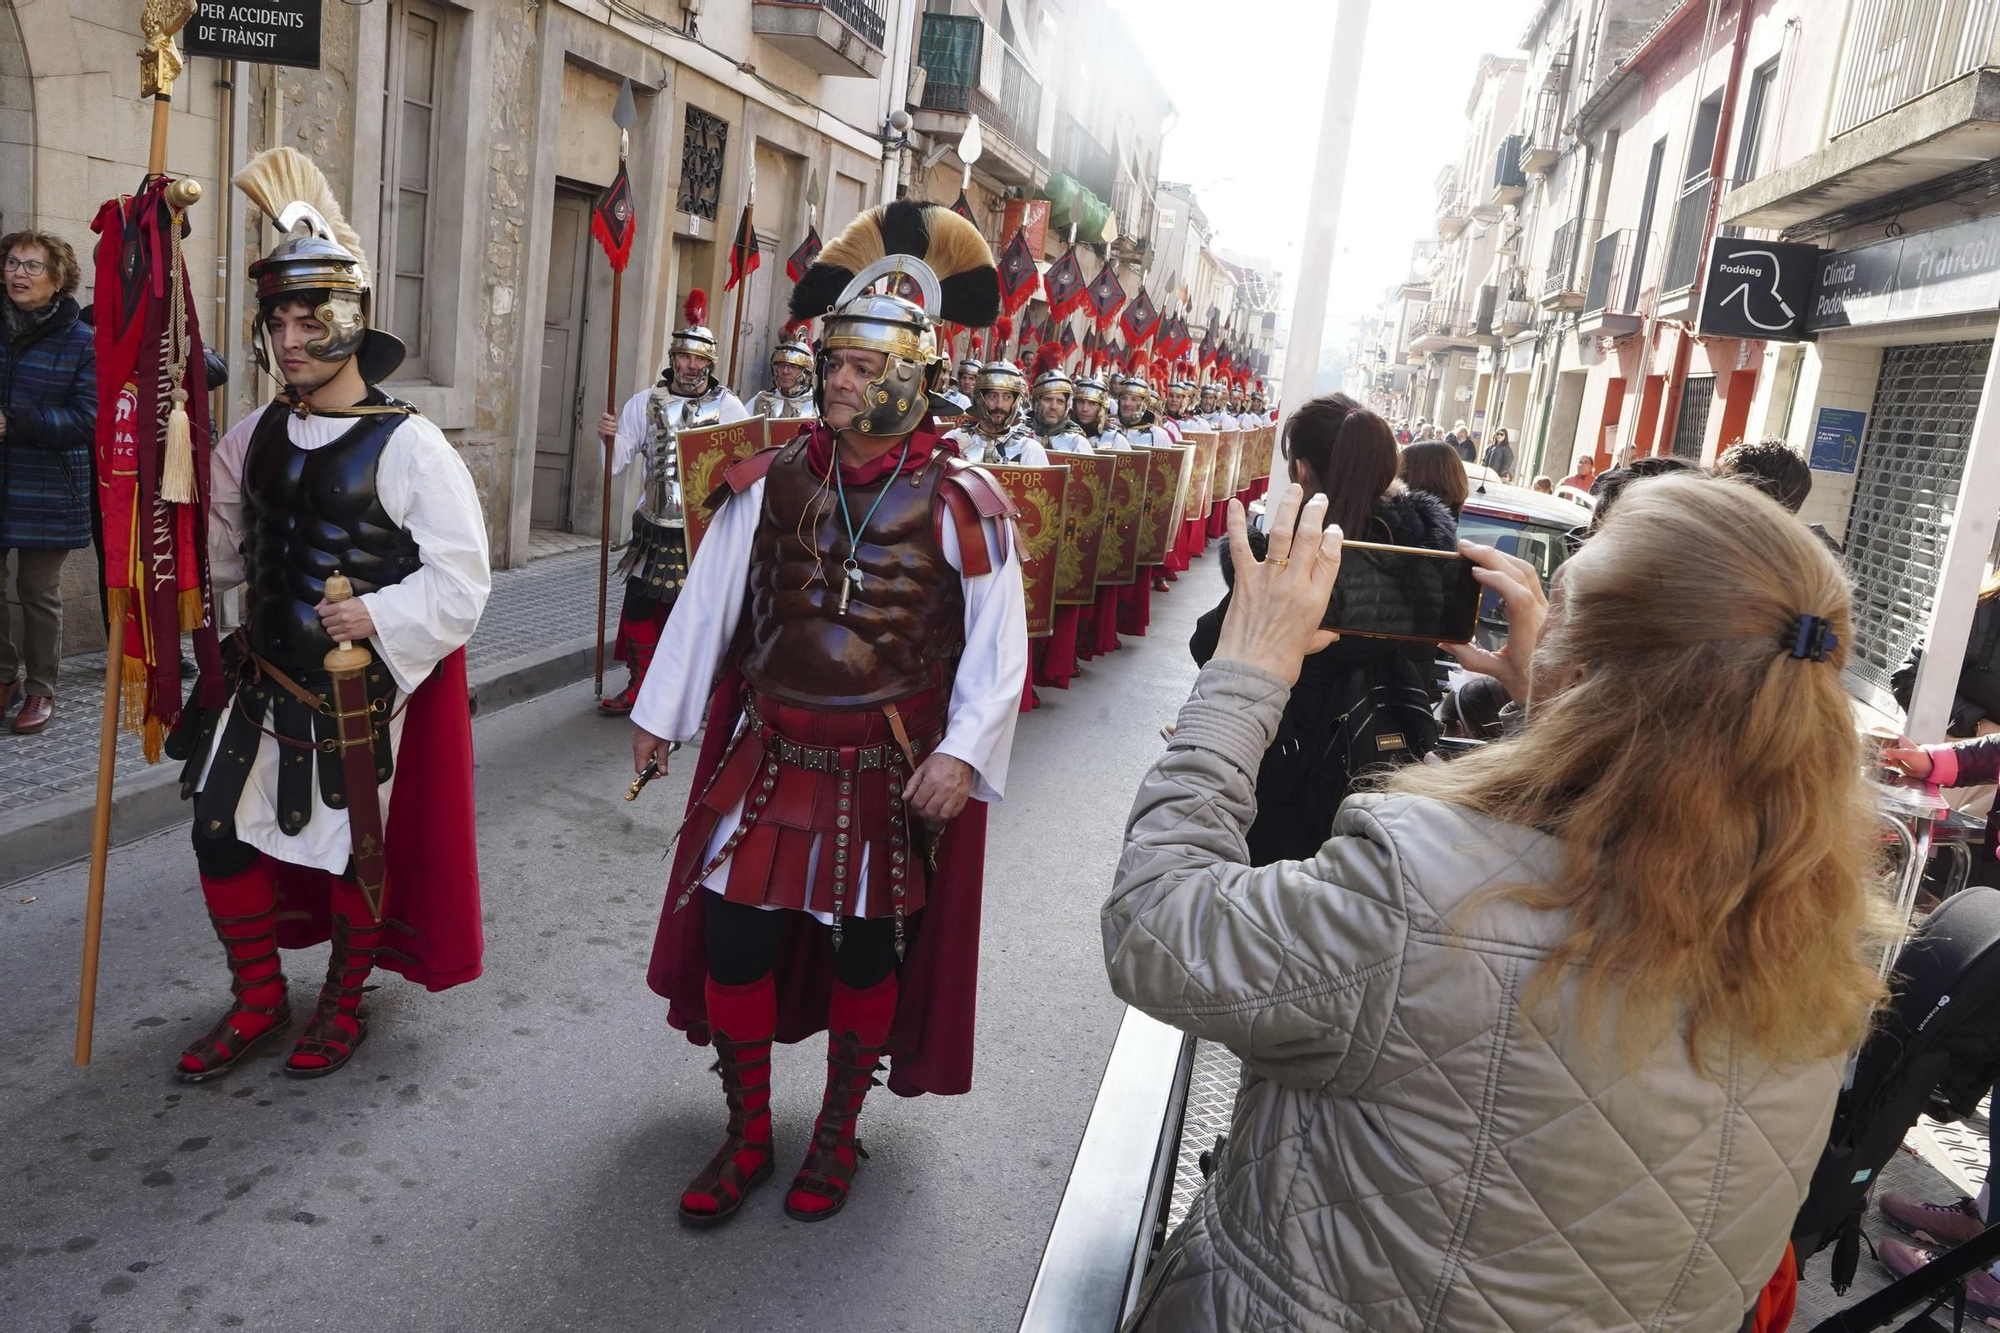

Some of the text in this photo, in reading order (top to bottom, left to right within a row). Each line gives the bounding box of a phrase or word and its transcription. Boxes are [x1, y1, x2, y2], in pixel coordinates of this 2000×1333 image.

[201, 3, 304, 28] PER ACCIDENTS
[199, 26, 277, 48] DE TRÀNSIT
[1720, 264, 1762, 278] Podòleg
[1823, 261, 1856, 287] Clínica
[710, 427, 747, 447] SPQR
[1064, 457, 1096, 473] SPQR
[1118, 456, 1132, 468] QR
[1150, 451, 1169, 463] PQR
[1001, 471, 1042, 488] SPQR
